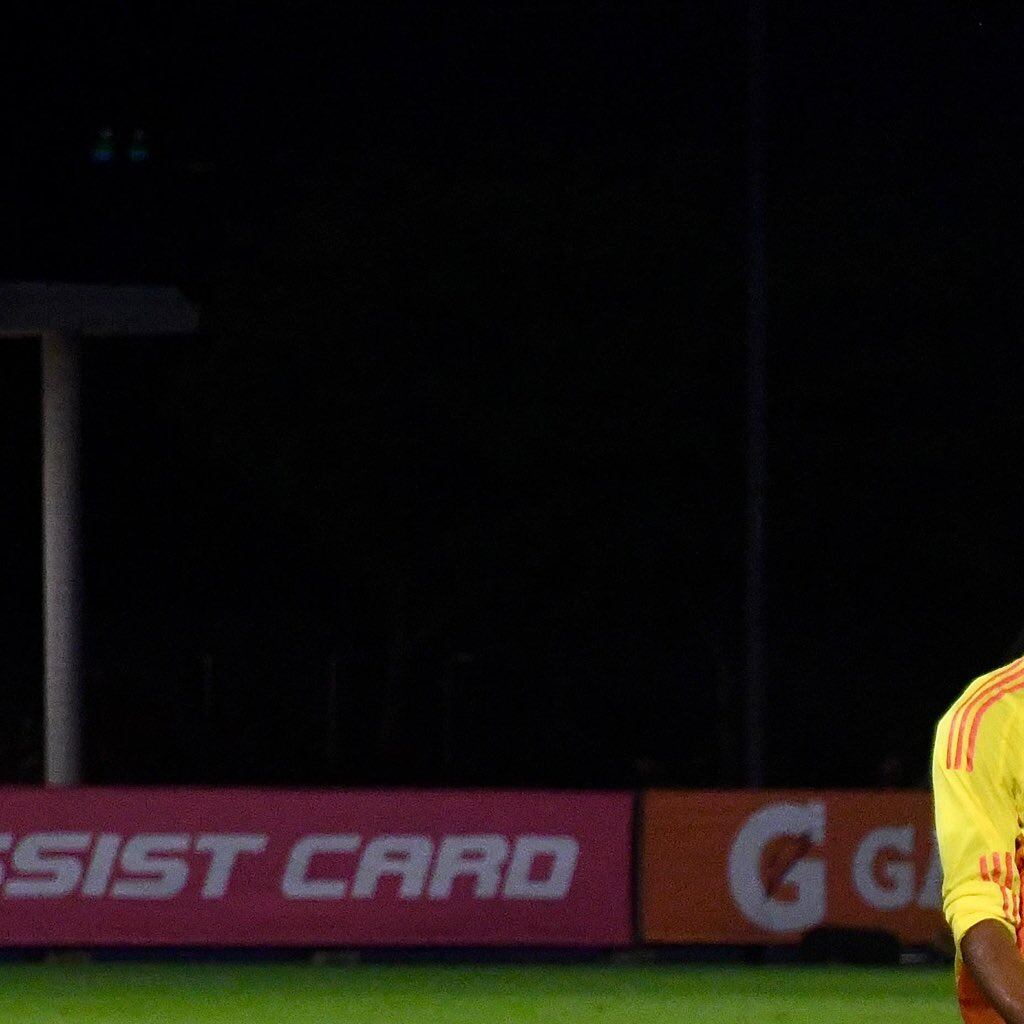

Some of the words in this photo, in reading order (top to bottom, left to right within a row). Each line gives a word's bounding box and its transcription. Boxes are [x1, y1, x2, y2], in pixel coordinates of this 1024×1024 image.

[0, 833, 269, 899] SIST
[281, 833, 580, 900] CARD
[728, 801, 827, 933] G
